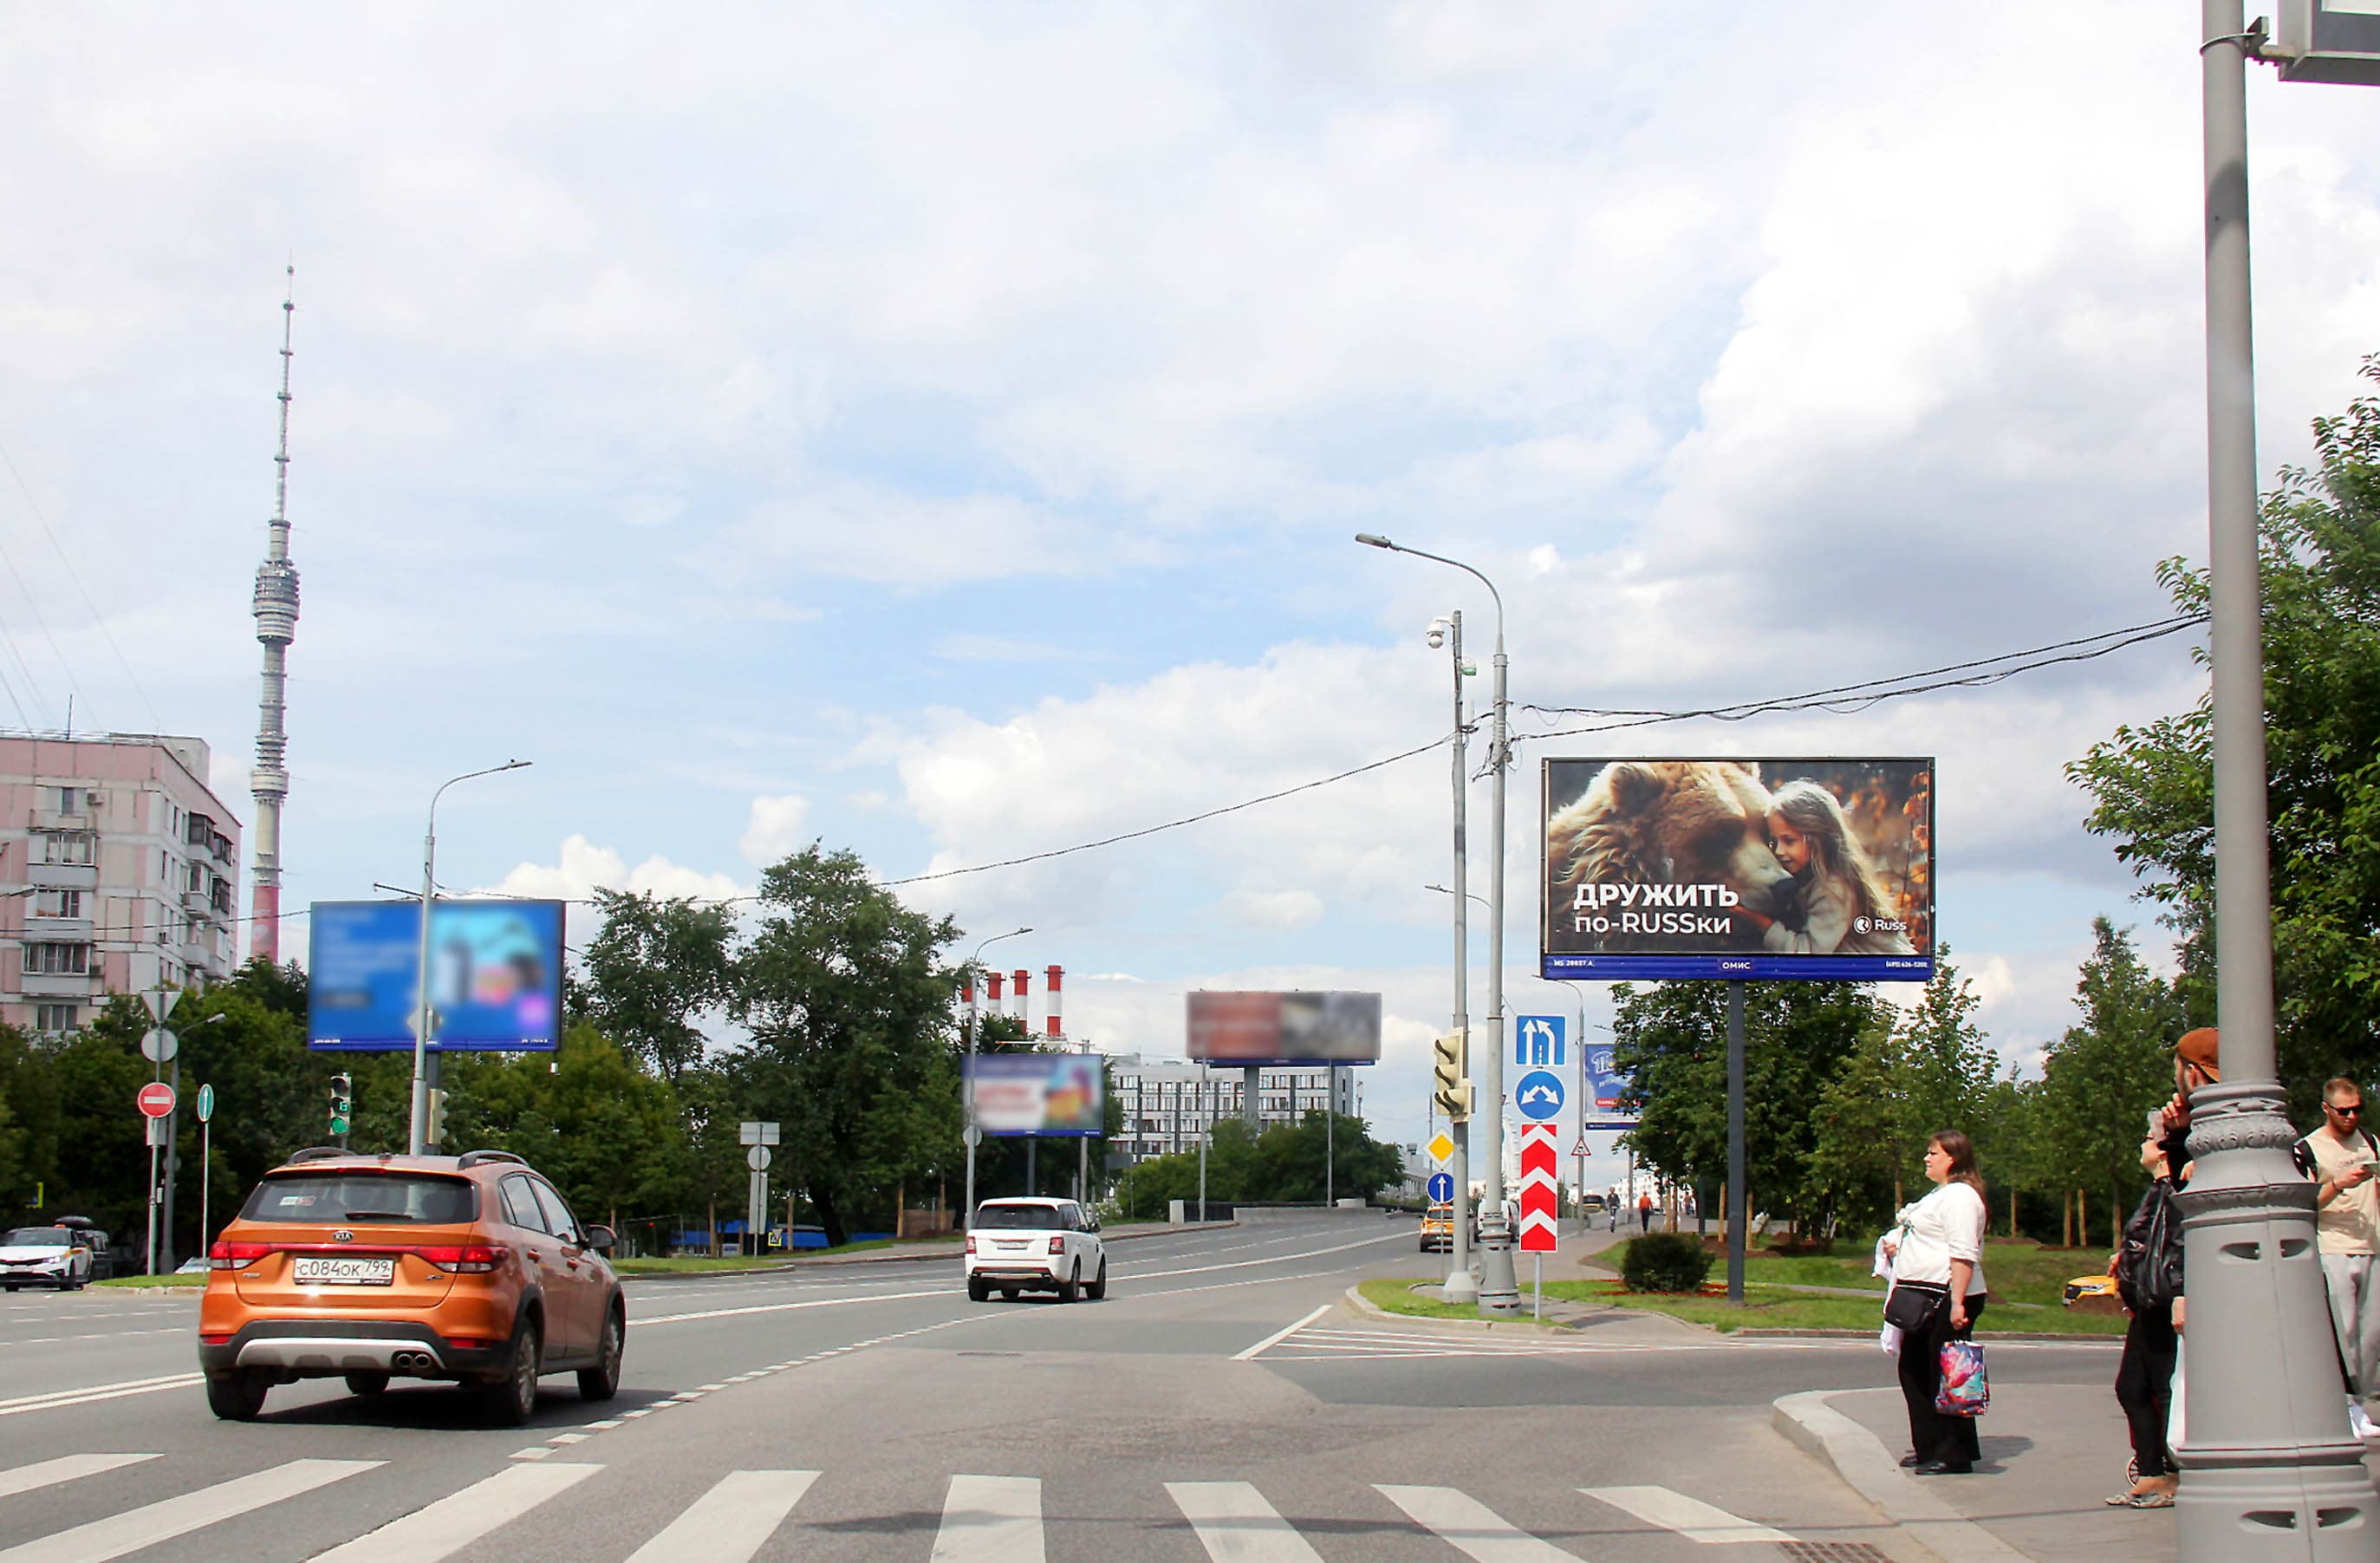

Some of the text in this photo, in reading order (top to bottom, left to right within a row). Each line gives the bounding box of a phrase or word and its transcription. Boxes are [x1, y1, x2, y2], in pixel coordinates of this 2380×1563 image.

[1573, 883, 1739, 910] ДРУЖИТЬ
[1575, 912, 1731, 934] по-RUSSки
[1874, 919, 1907, 931] Russ
[339, 1100, 348, 1111] 6
[299, 1260, 389, 1277] С084ОК 799
